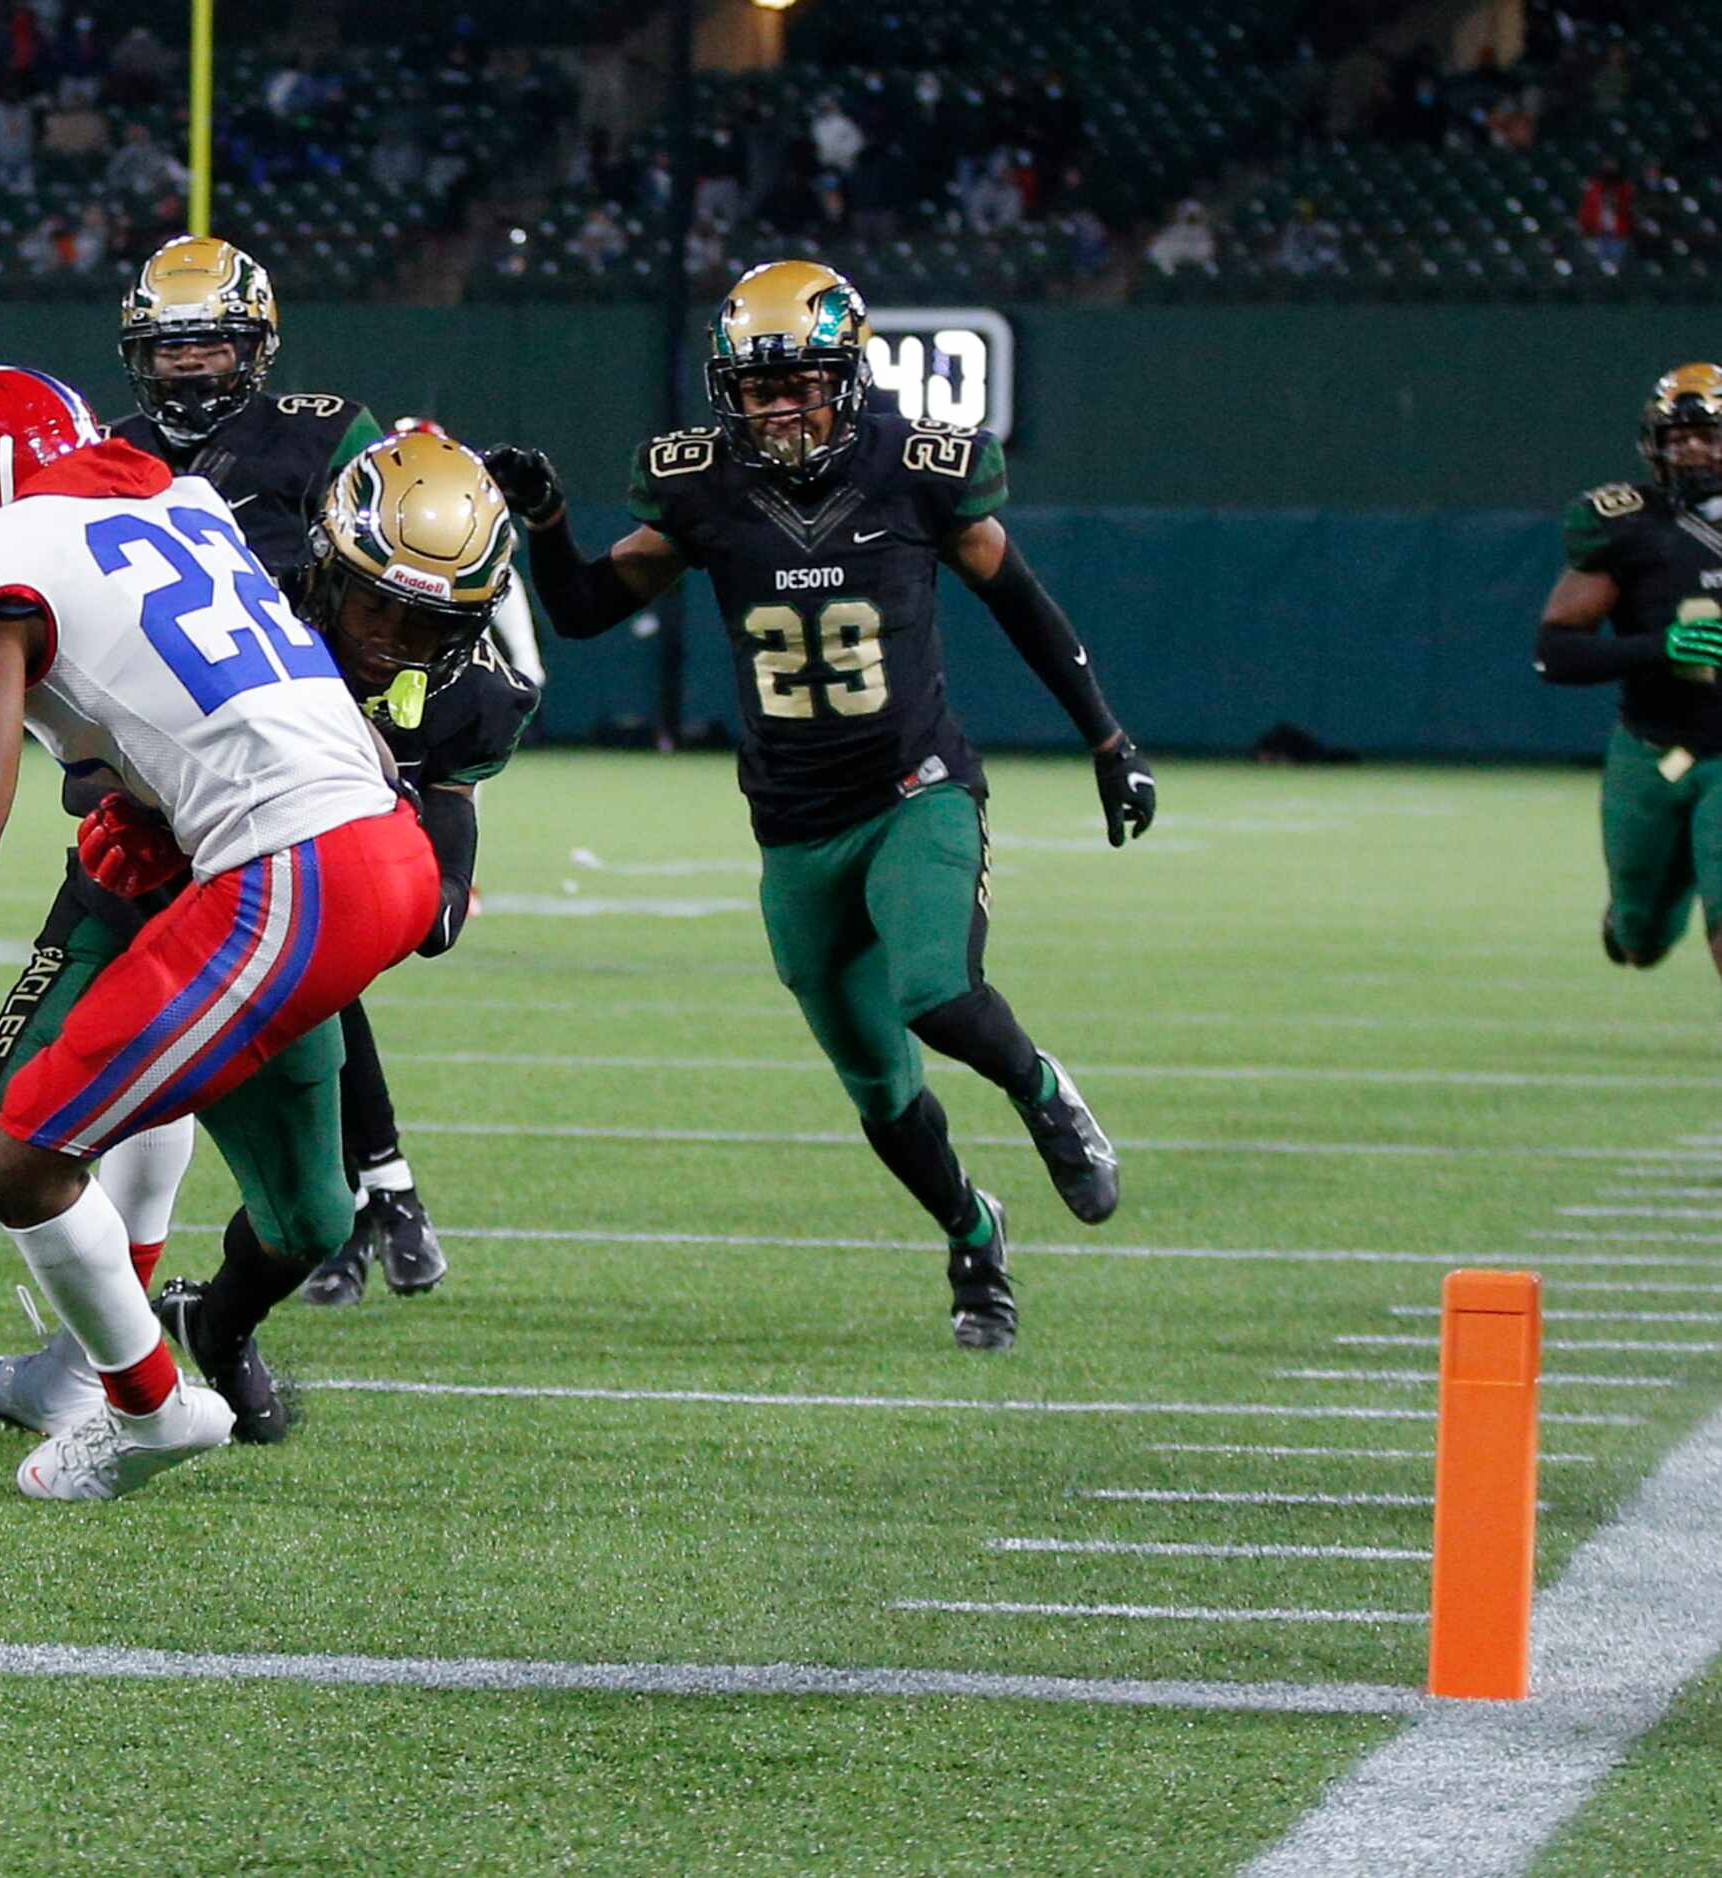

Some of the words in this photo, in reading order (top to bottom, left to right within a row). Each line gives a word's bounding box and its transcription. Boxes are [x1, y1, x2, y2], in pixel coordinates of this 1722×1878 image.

[277, 393, 344, 417] 3
[393, 569, 445, 594] Riddell
[775, 566, 845, 590] DESOTO
[84, 505, 344, 717] 22
[744, 601, 887, 719] 29
